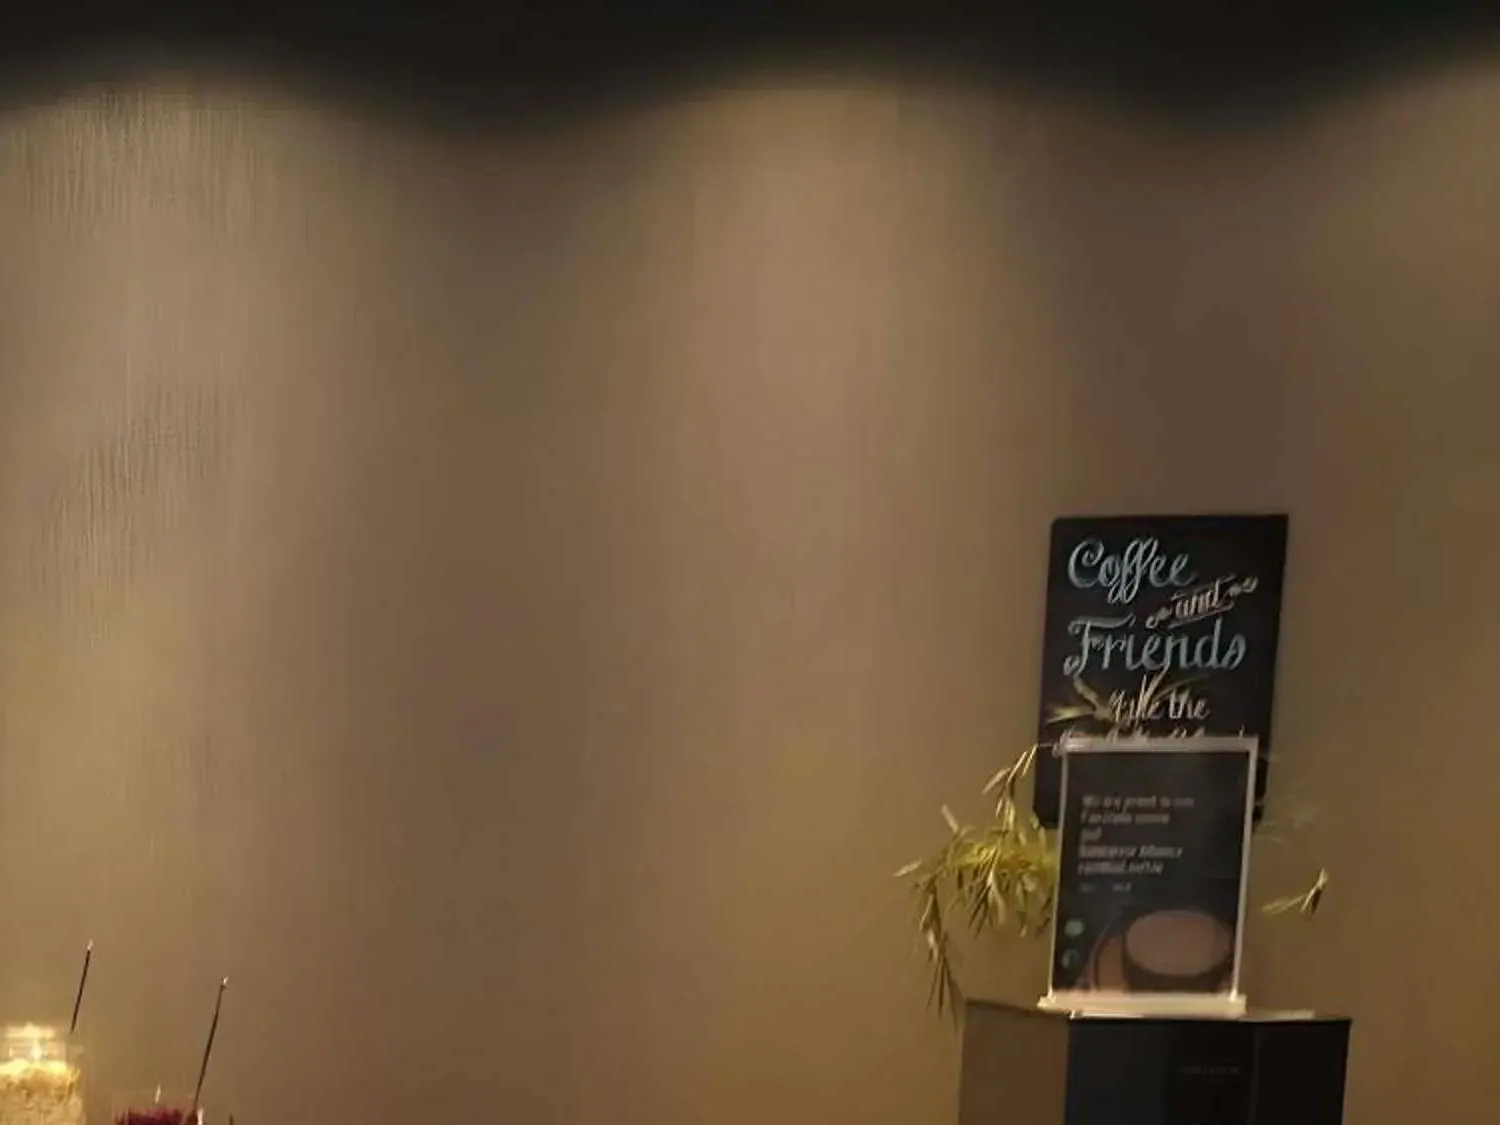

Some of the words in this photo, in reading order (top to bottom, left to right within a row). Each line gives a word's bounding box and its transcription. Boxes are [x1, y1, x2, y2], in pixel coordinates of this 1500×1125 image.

[1067, 536, 1198, 605] Coffee
[1175, 578, 1222, 619] and
[1063, 612, 1248, 676] Friends
